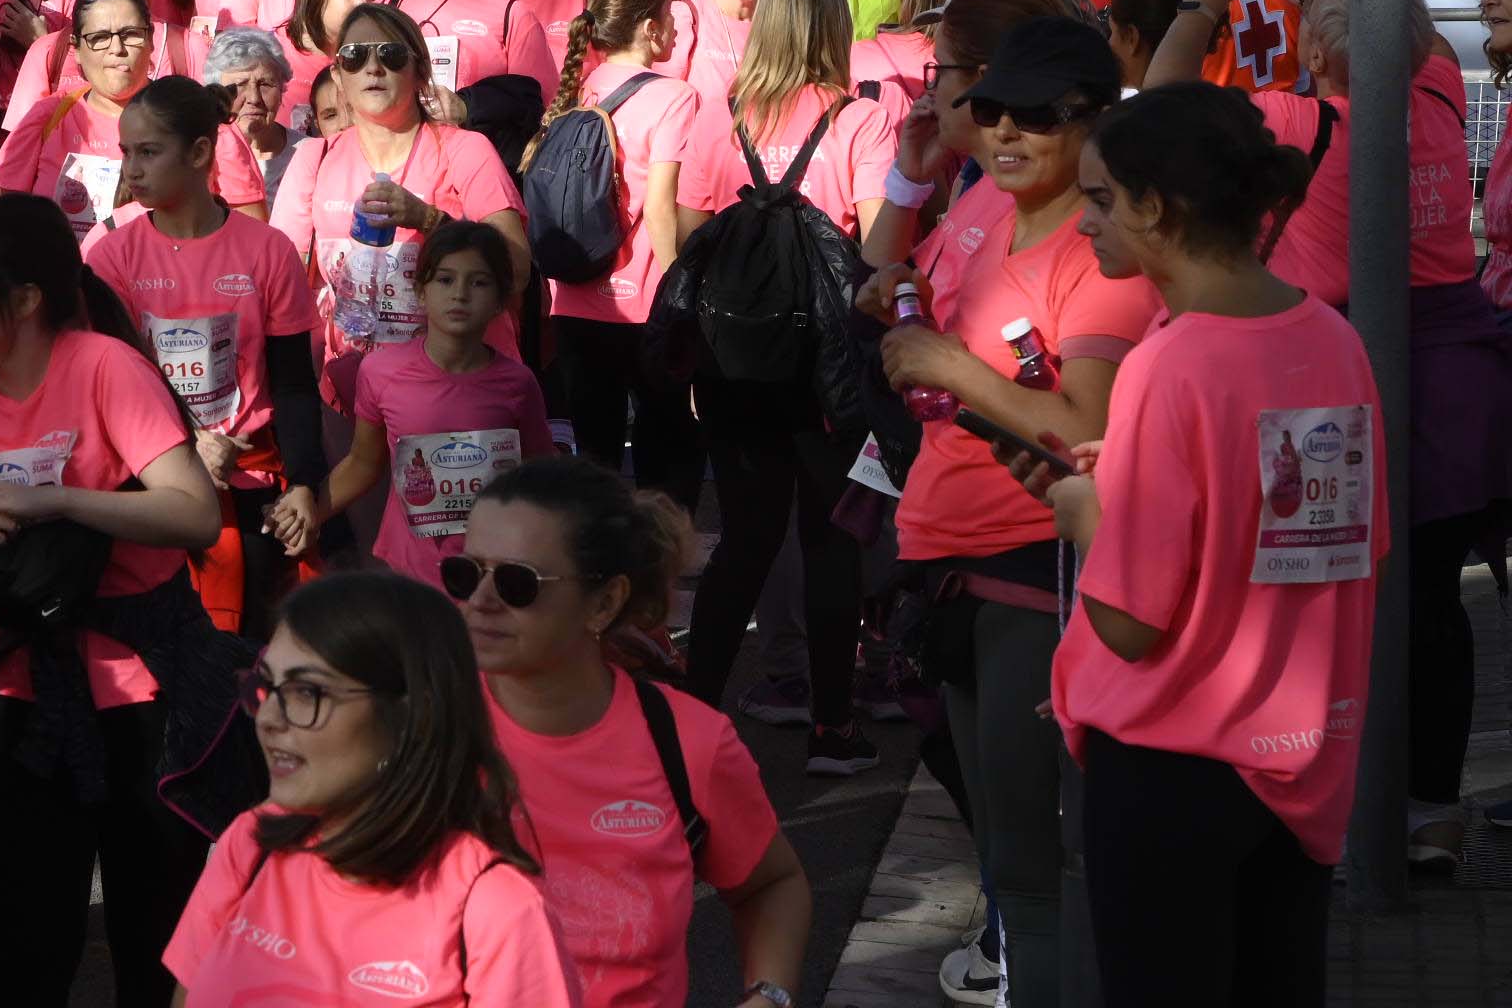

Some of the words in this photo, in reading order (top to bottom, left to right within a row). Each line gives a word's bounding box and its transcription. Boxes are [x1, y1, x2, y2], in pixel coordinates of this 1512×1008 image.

[159, 337, 204, 348] ASTURIANA
[162, 361, 204, 378] 016
[435, 454, 483, 464] ASTURIANA
[1267, 557, 1310, 572] OYSHO
[1251, 728, 1325, 755] OYSHO
[597, 815, 660, 830] ASTURIANA
